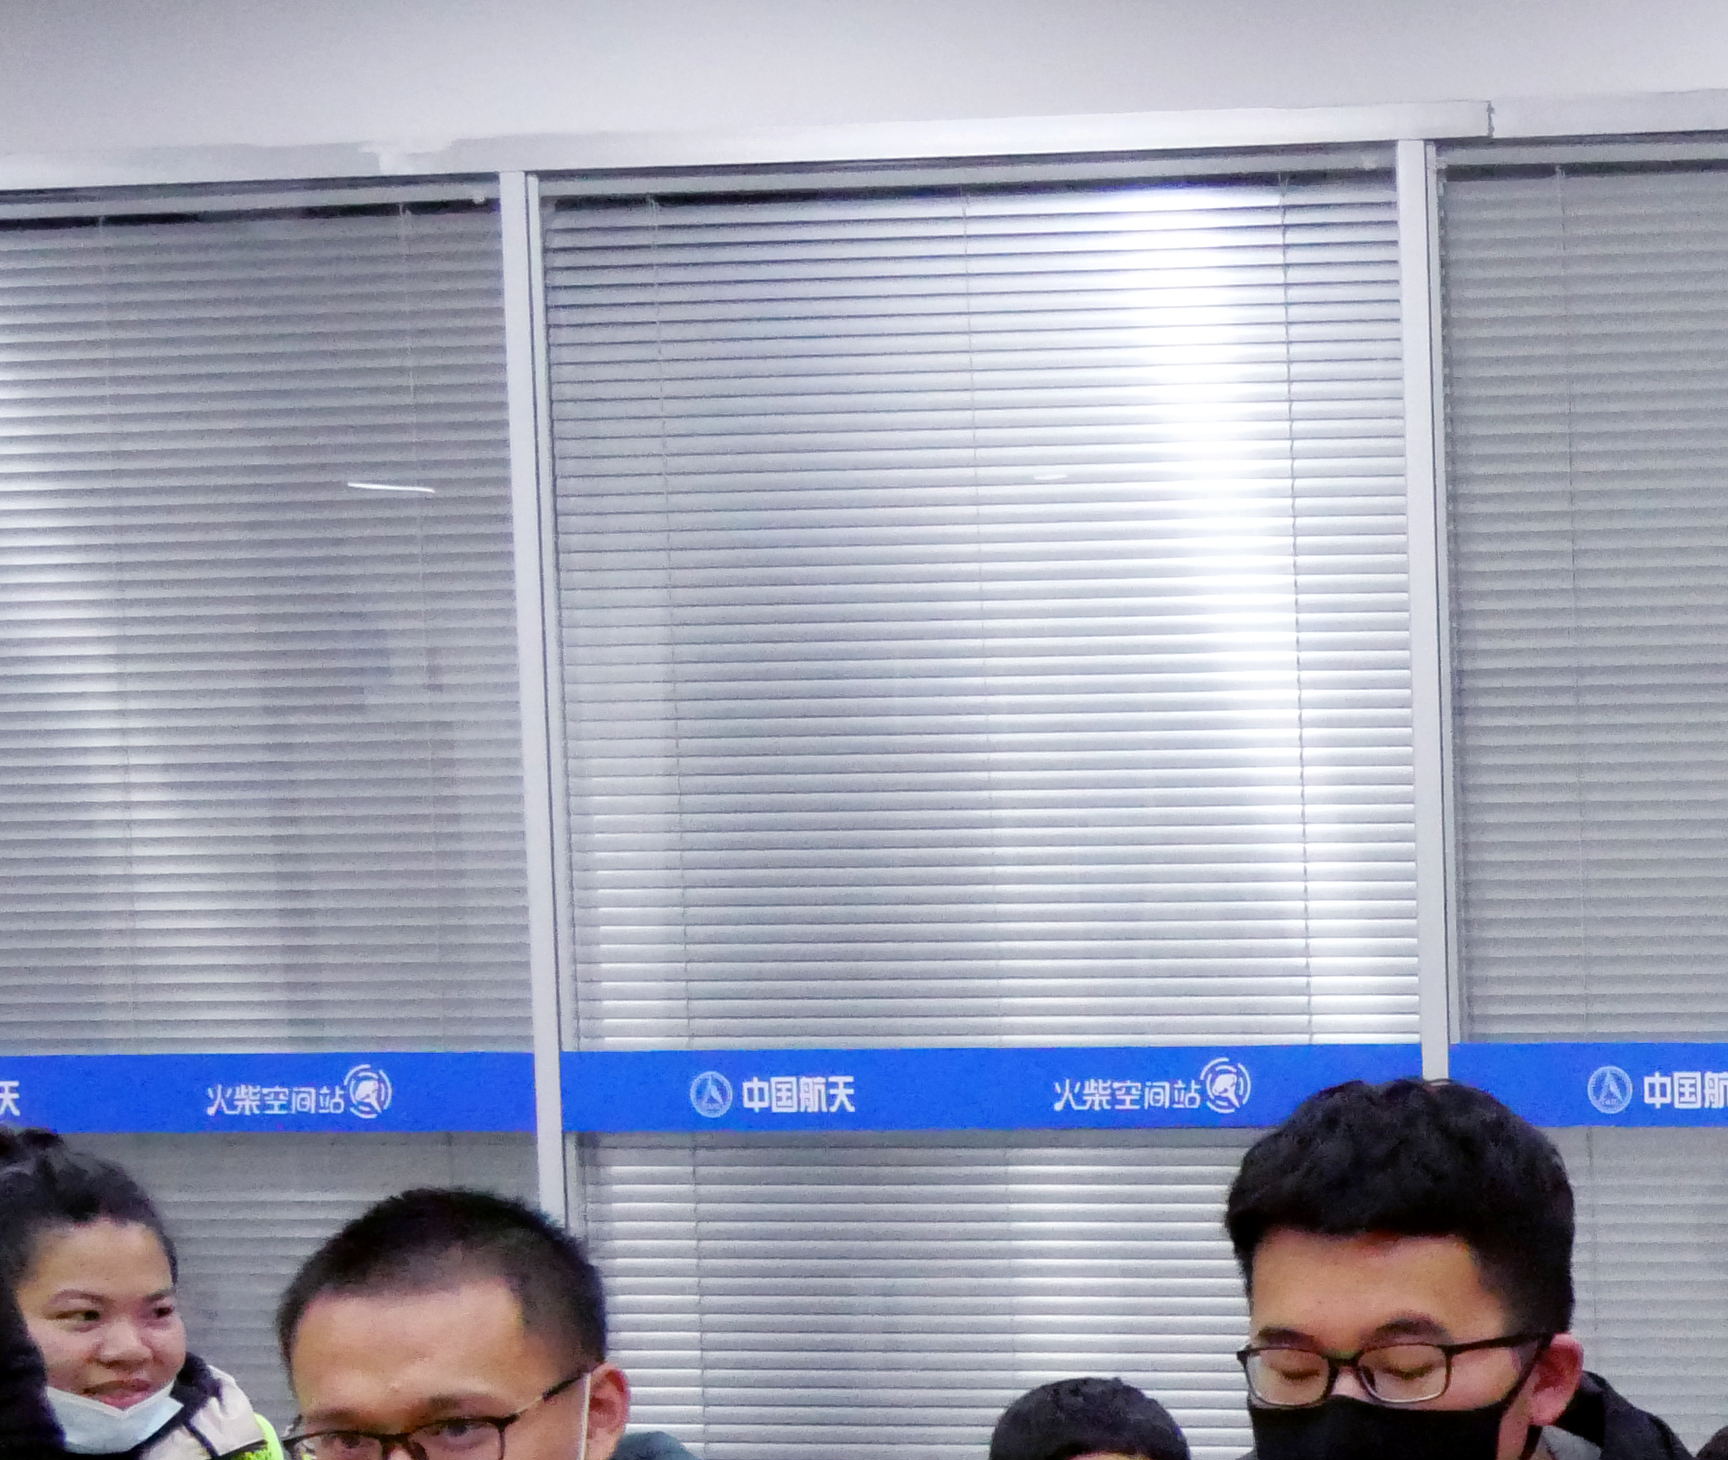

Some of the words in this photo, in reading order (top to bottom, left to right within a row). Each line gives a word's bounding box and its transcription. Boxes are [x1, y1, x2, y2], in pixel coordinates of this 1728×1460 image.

[206, 1081, 345, 1117] 火柴空间站
[742, 1075, 856, 1113] 中国航天
[1053, 1078, 1200, 1112] 火柴空间站
